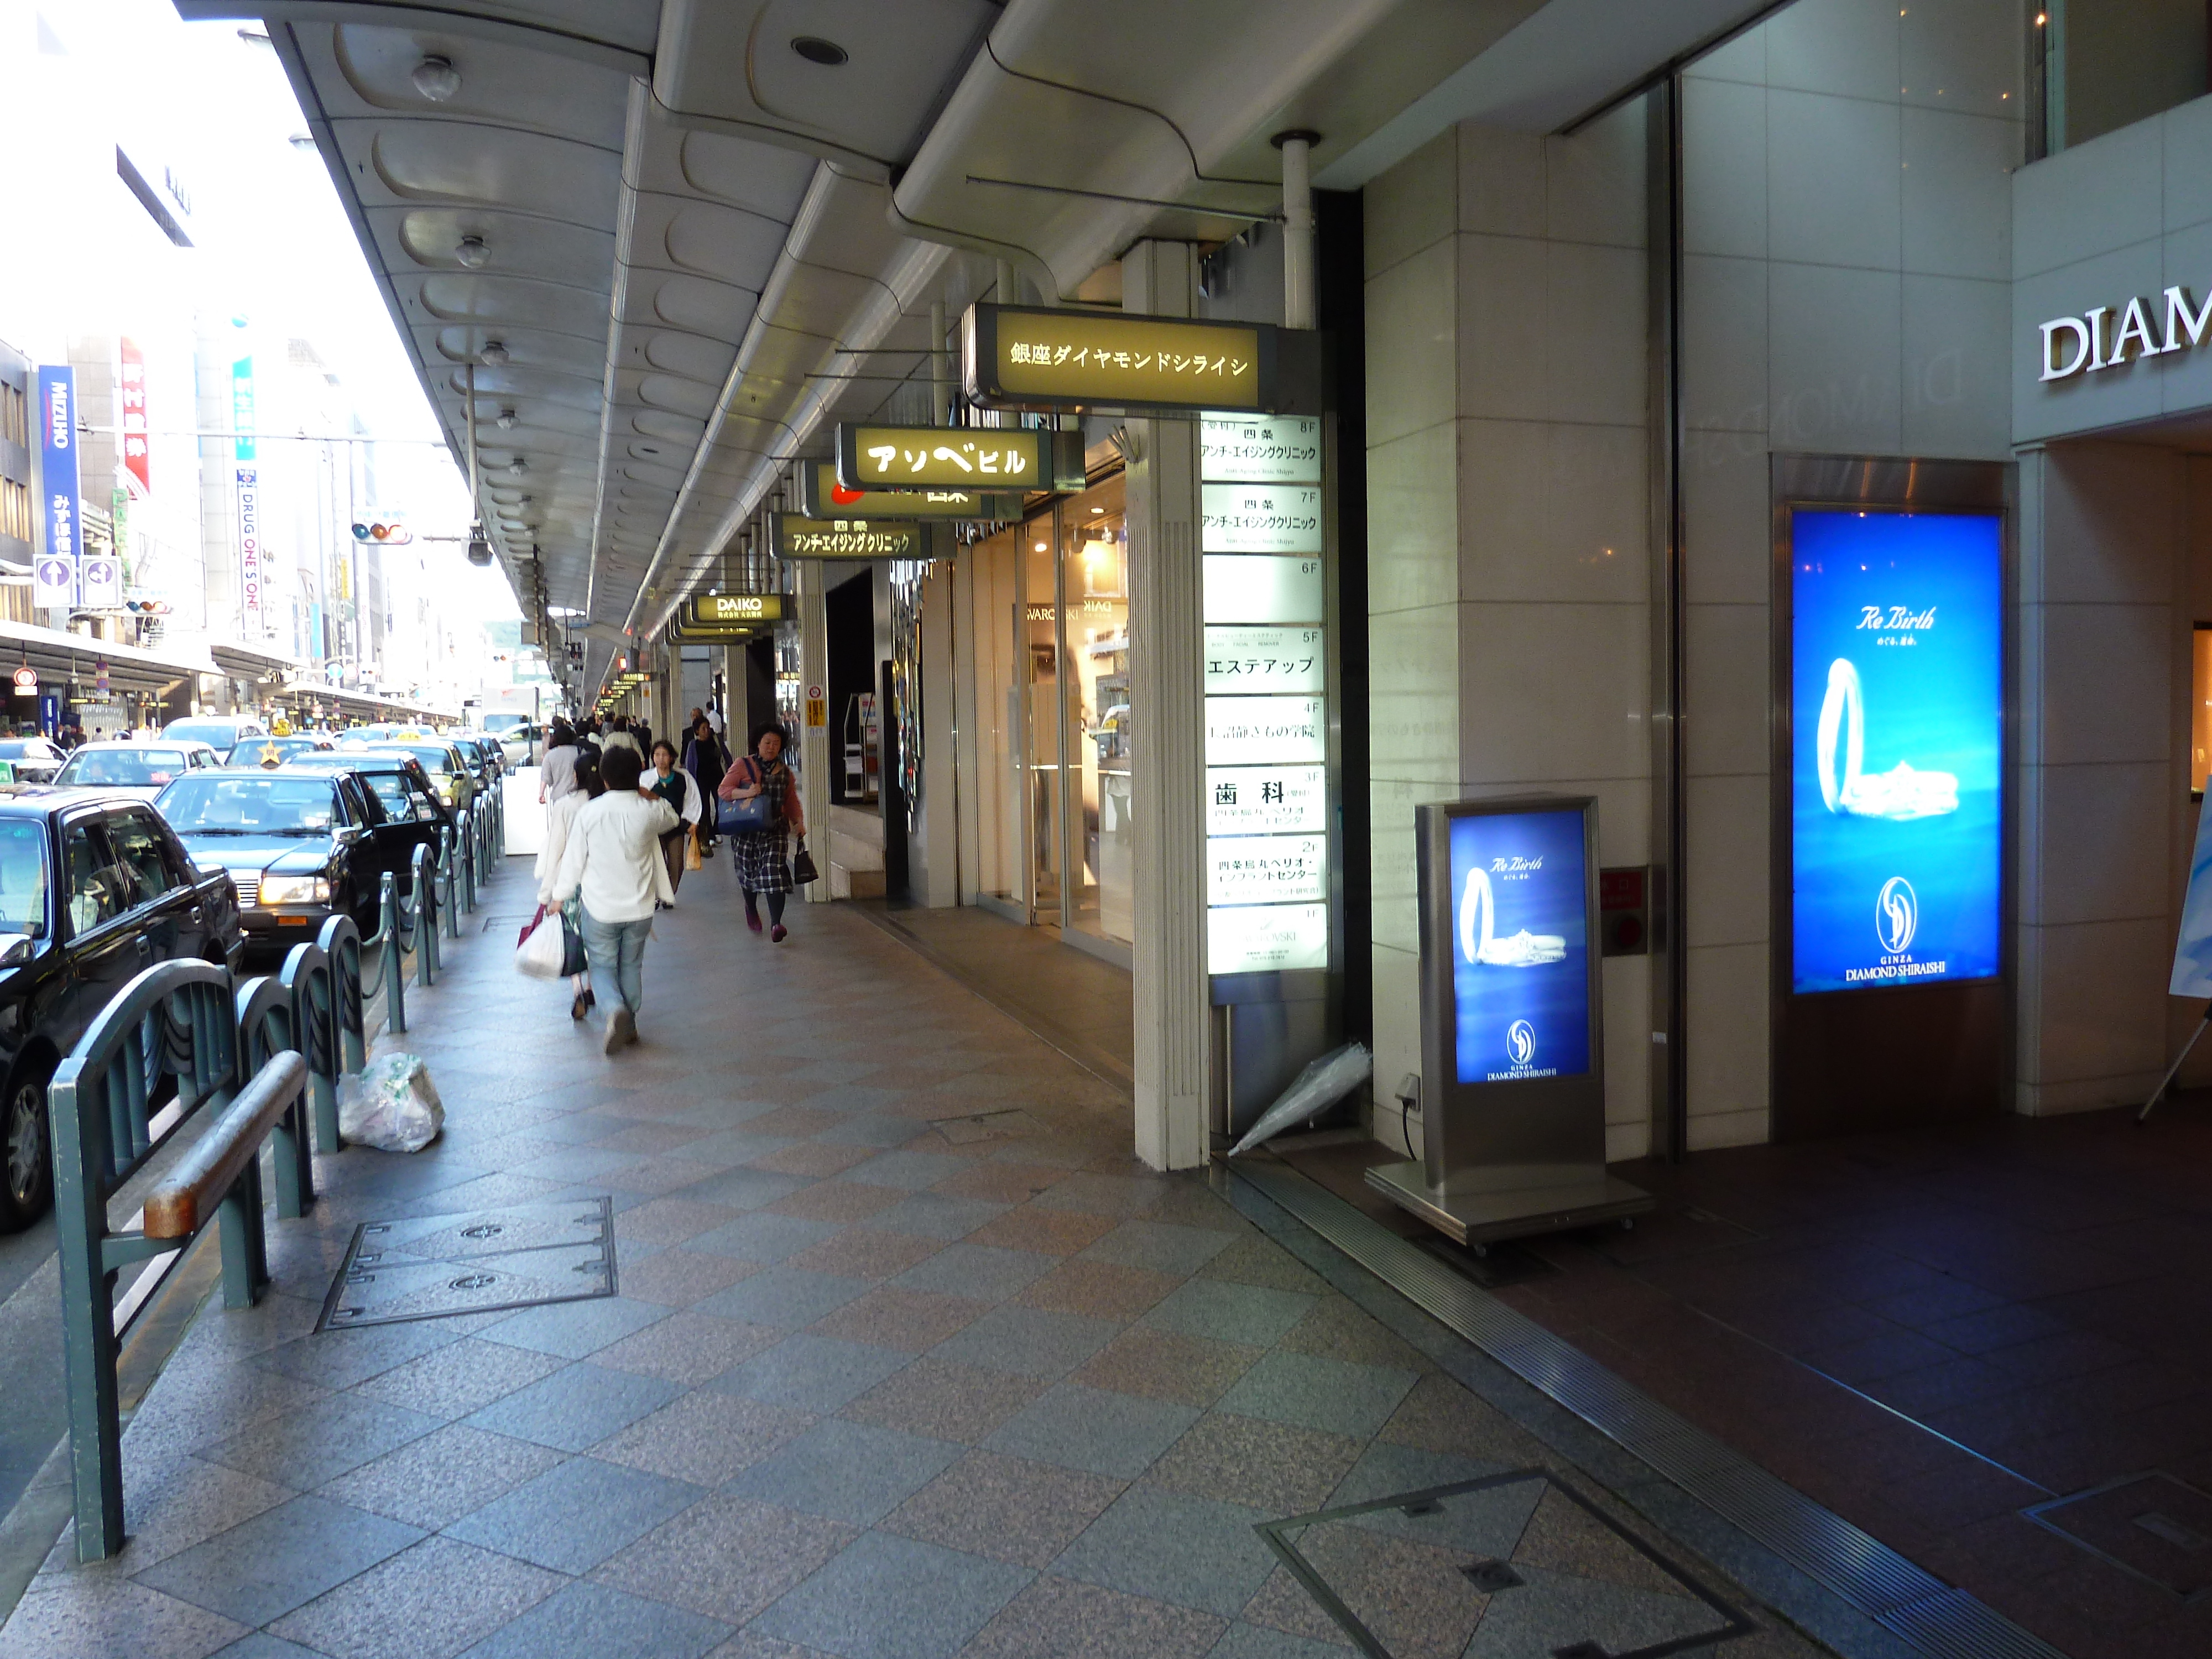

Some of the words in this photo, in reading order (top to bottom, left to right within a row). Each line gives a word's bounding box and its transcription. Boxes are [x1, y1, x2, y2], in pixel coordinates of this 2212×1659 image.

[1010, 341, 1248, 377] 銀座ダイヤモンドシライシ
[51, 381, 69, 449] MIZUHO
[1300, 422, 1316, 433] 8F
[868, 442, 1026, 474] アソベビル
[1301, 492, 1316, 503] 7F
[243, 494, 254, 534] DRUG
[54, 494, 72, 555] みずほ信
[1301, 562, 1317, 574] 6F
[717, 598, 762, 611] DAIKO
[1027, 608, 1078, 620] WAROSKI
[1856, 606, 1884, 629] Re
[1884, 606, 1936, 629] Birth
[1303, 632, 1318, 643] 5F
[1208, 656, 1314, 674] エステアップ
[1304, 702, 1319, 713] 4F
[1302, 841, 1319, 852] 2F
[1490, 857, 1507, 873] Re
[1508, 855, 1544, 872] Birth
[1239, 931, 1296, 942] WROVSKI
[1881, 954, 1912, 965] GINZA
[1846, 966, 1897, 982] DIAMOND
[1898, 961, 1945, 977] SHIRAISHI
[1488, 1071, 1523, 1081] DIAMOND
[1523, 1067, 1556, 1078] SHIRAISHI
